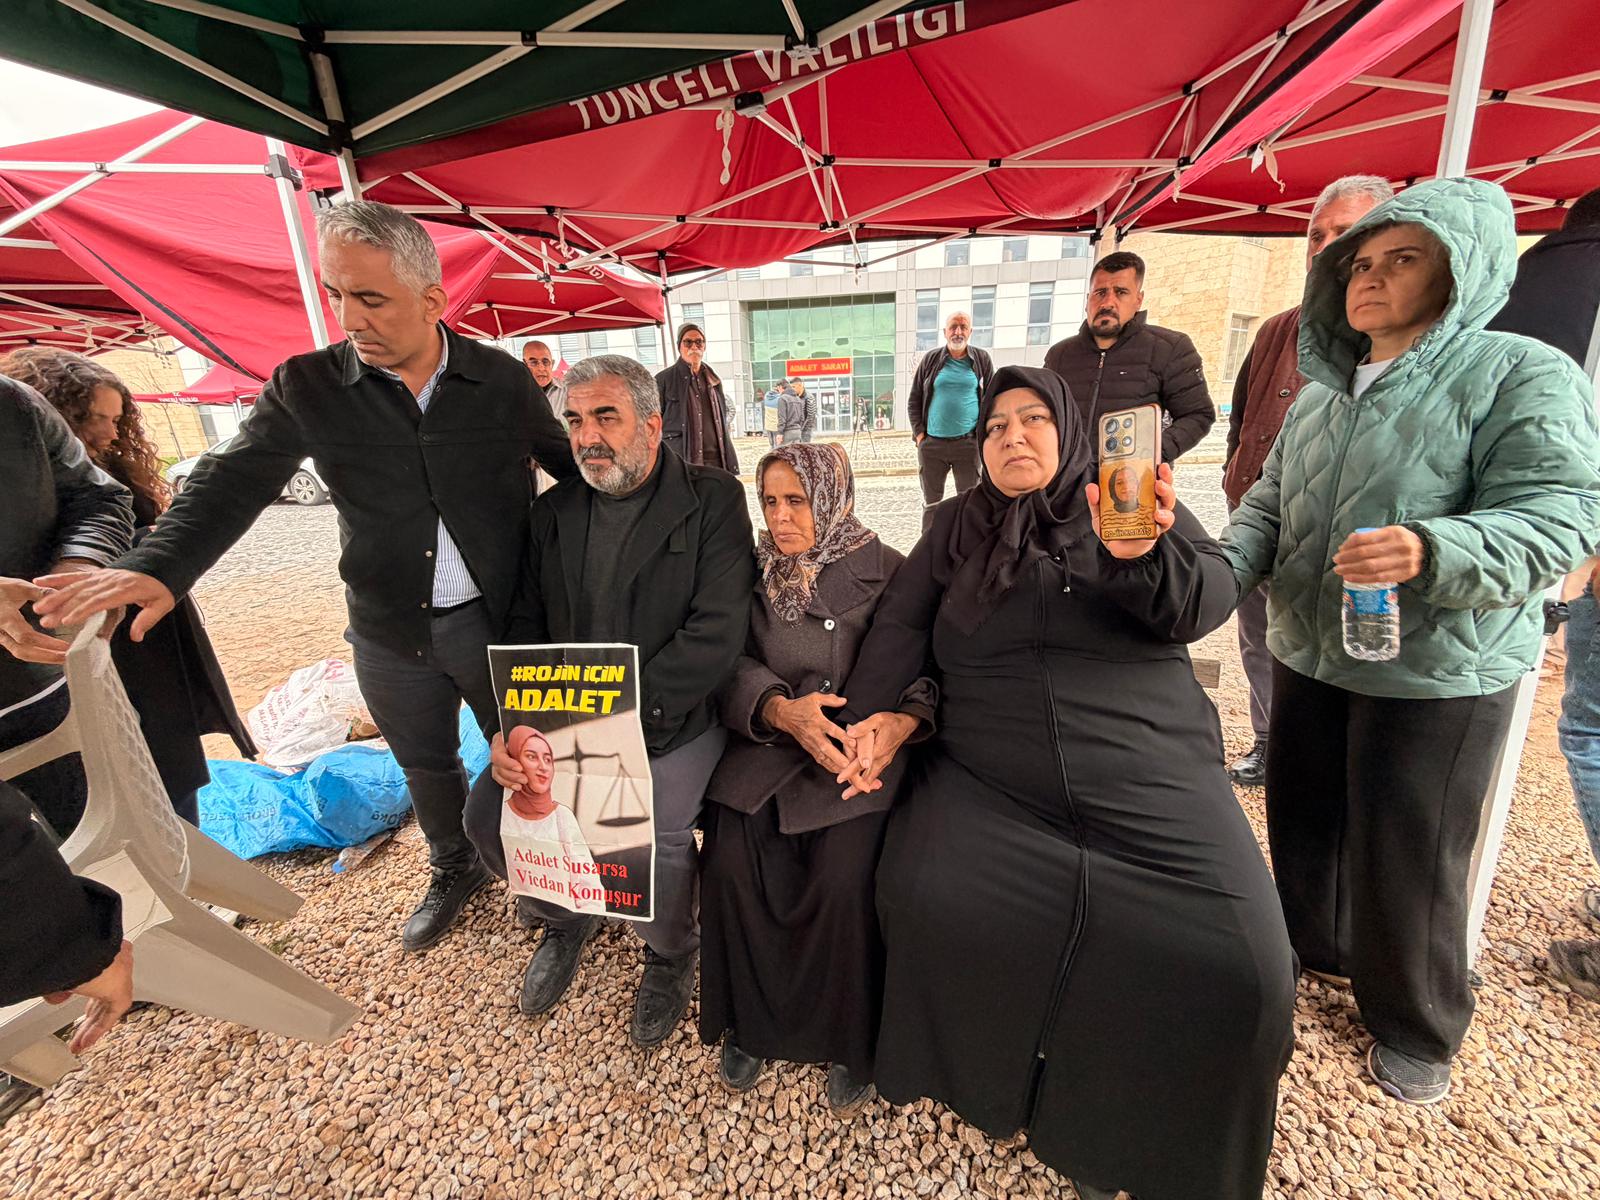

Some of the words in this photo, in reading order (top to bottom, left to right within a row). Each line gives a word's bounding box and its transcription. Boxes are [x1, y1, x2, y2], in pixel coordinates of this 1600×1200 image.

[790, 363, 817, 372] ADALET
[821, 362, 849, 371] SARAYI
[511, 665, 581, 682] #ROJİN
[583, 665, 625, 684] İÇİN
[504, 688, 621, 714] ADALET
[513, 847, 560, 870] Adalet
[562, 855, 628, 878] Susarsa
[516, 868, 565, 894] Vicdan
[568, 882, 643, 908] Konuşur
